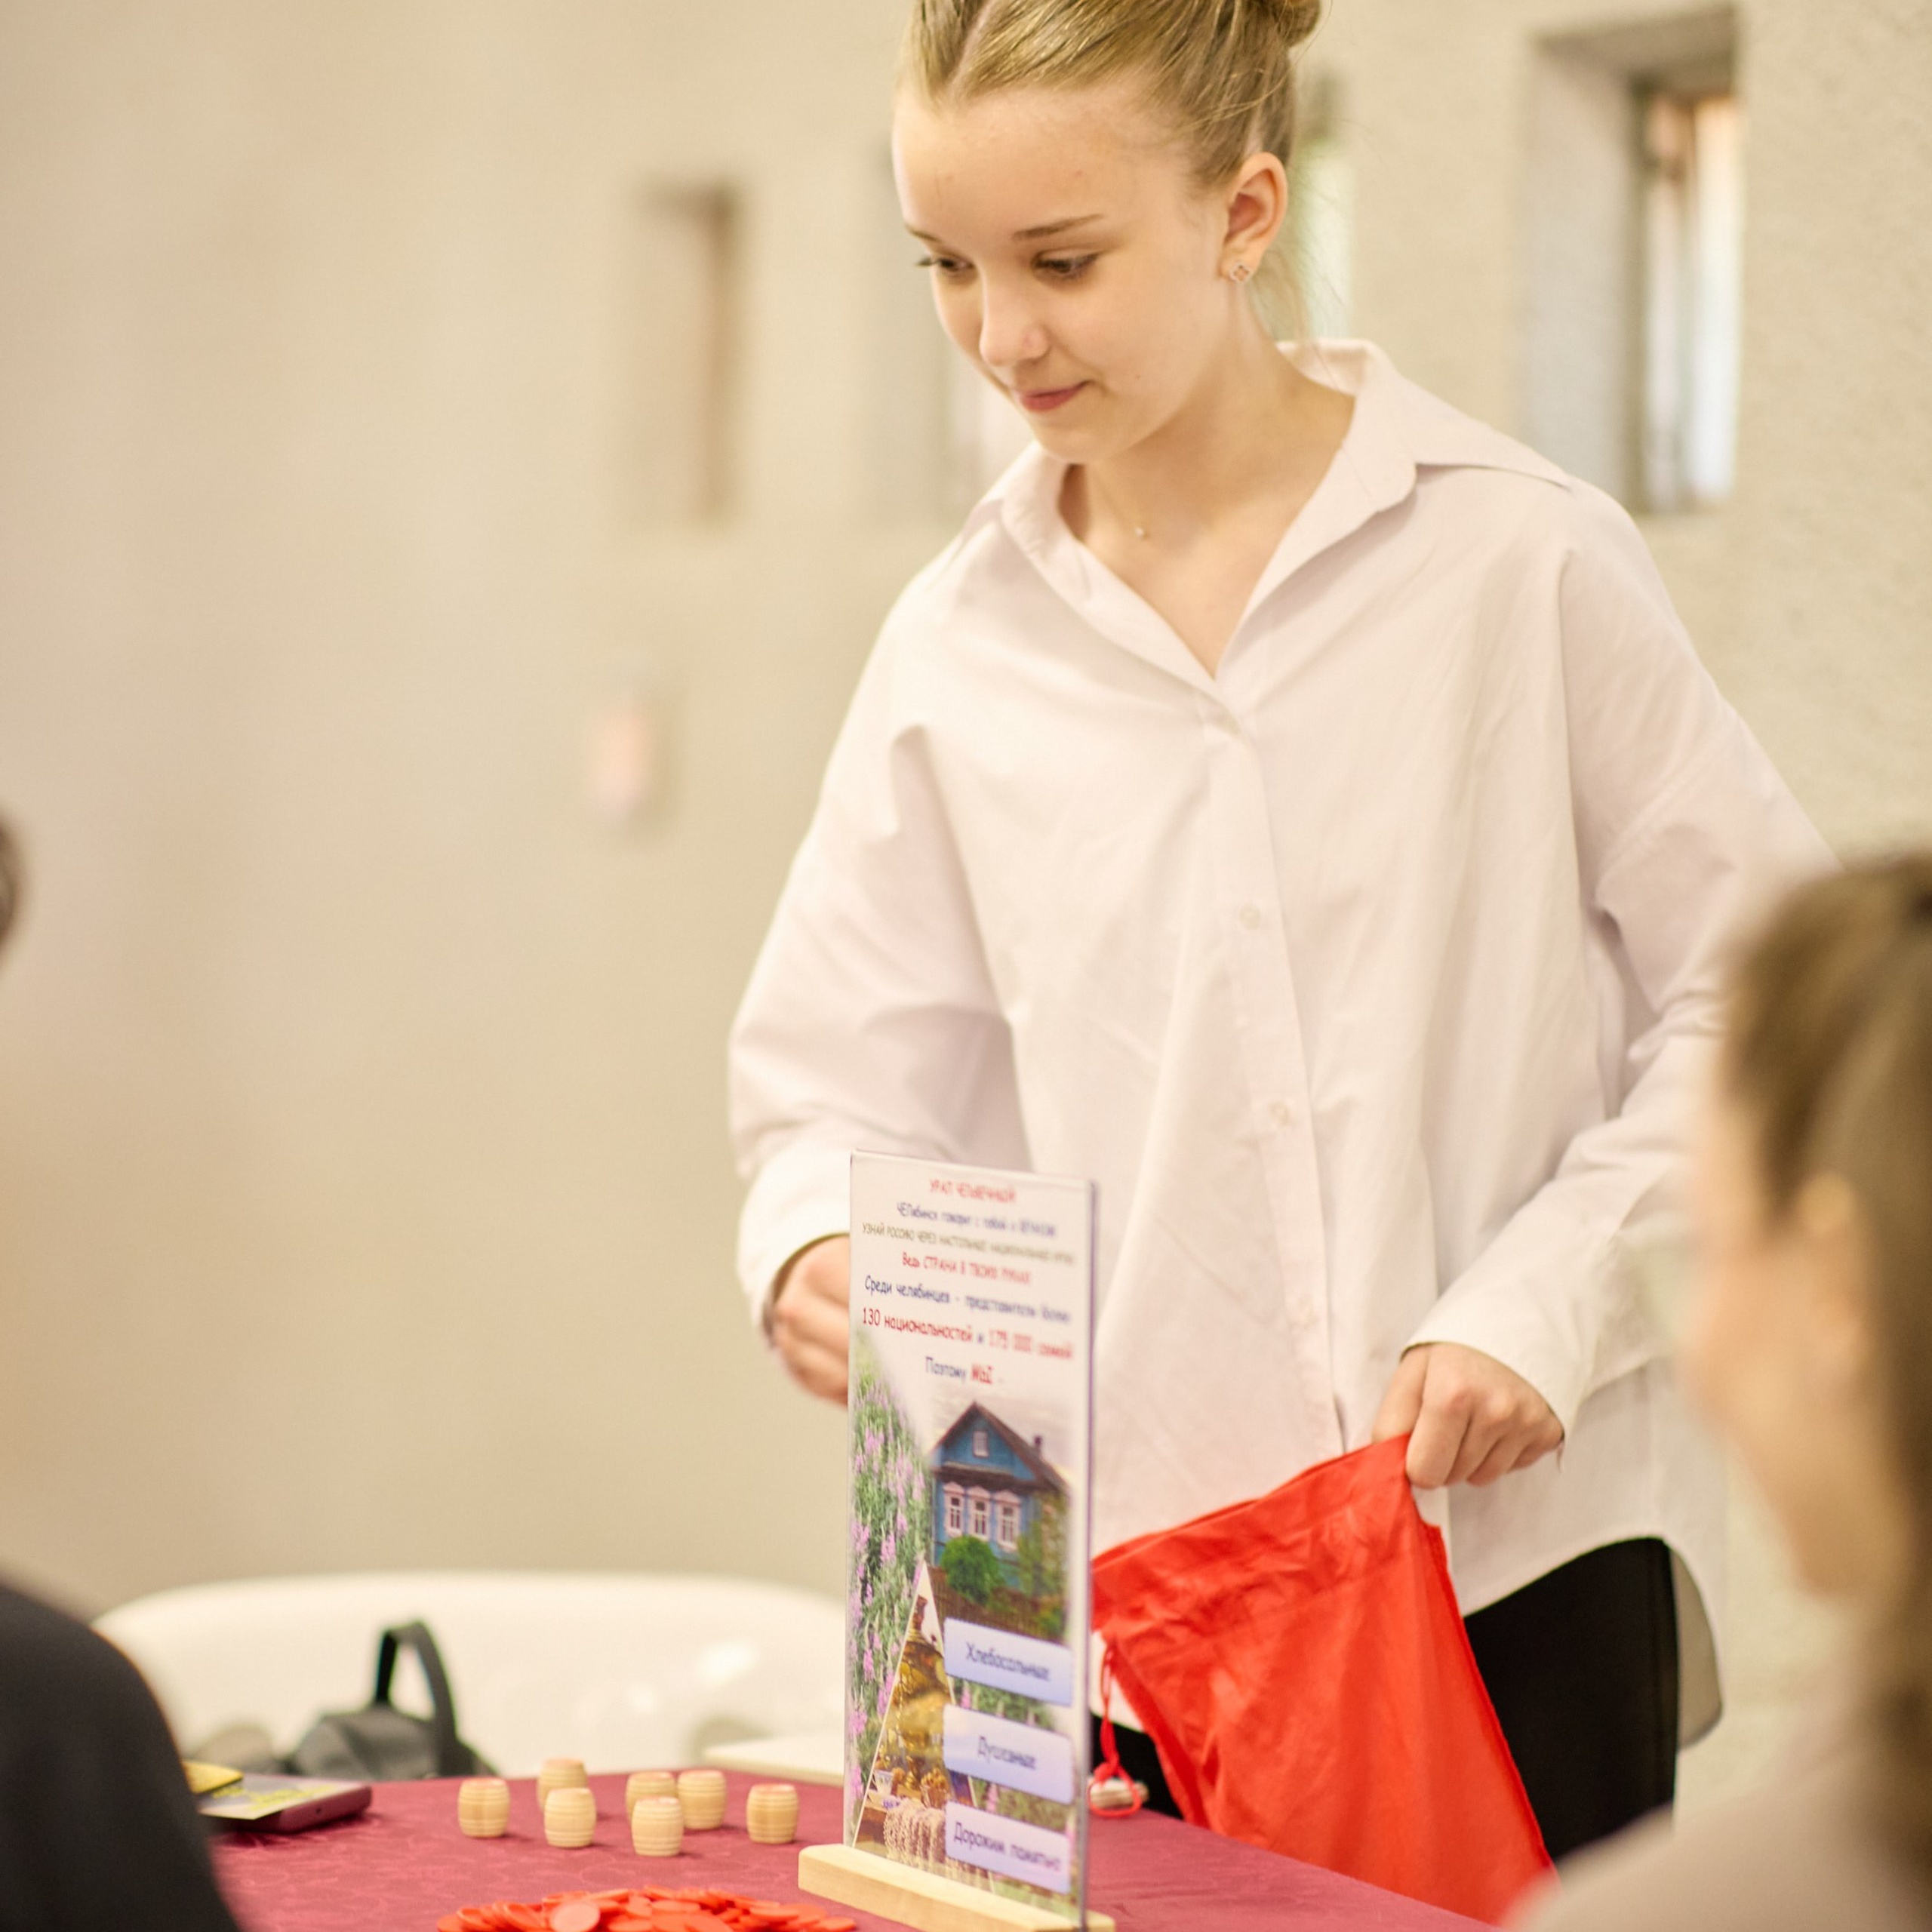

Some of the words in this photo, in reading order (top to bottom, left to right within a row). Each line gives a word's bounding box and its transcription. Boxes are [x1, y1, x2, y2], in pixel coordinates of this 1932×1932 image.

[864, 1275, 892, 1297] Среди
[896, 1284, 950, 1304] челябинцев
[862, 1306, 881, 1327] 130
[884, 1315, 974, 1343] национальностей
[965, 1641, 1051, 1683] Хлебосольные
[953, 1821, 1006, 1855] Дорожим
